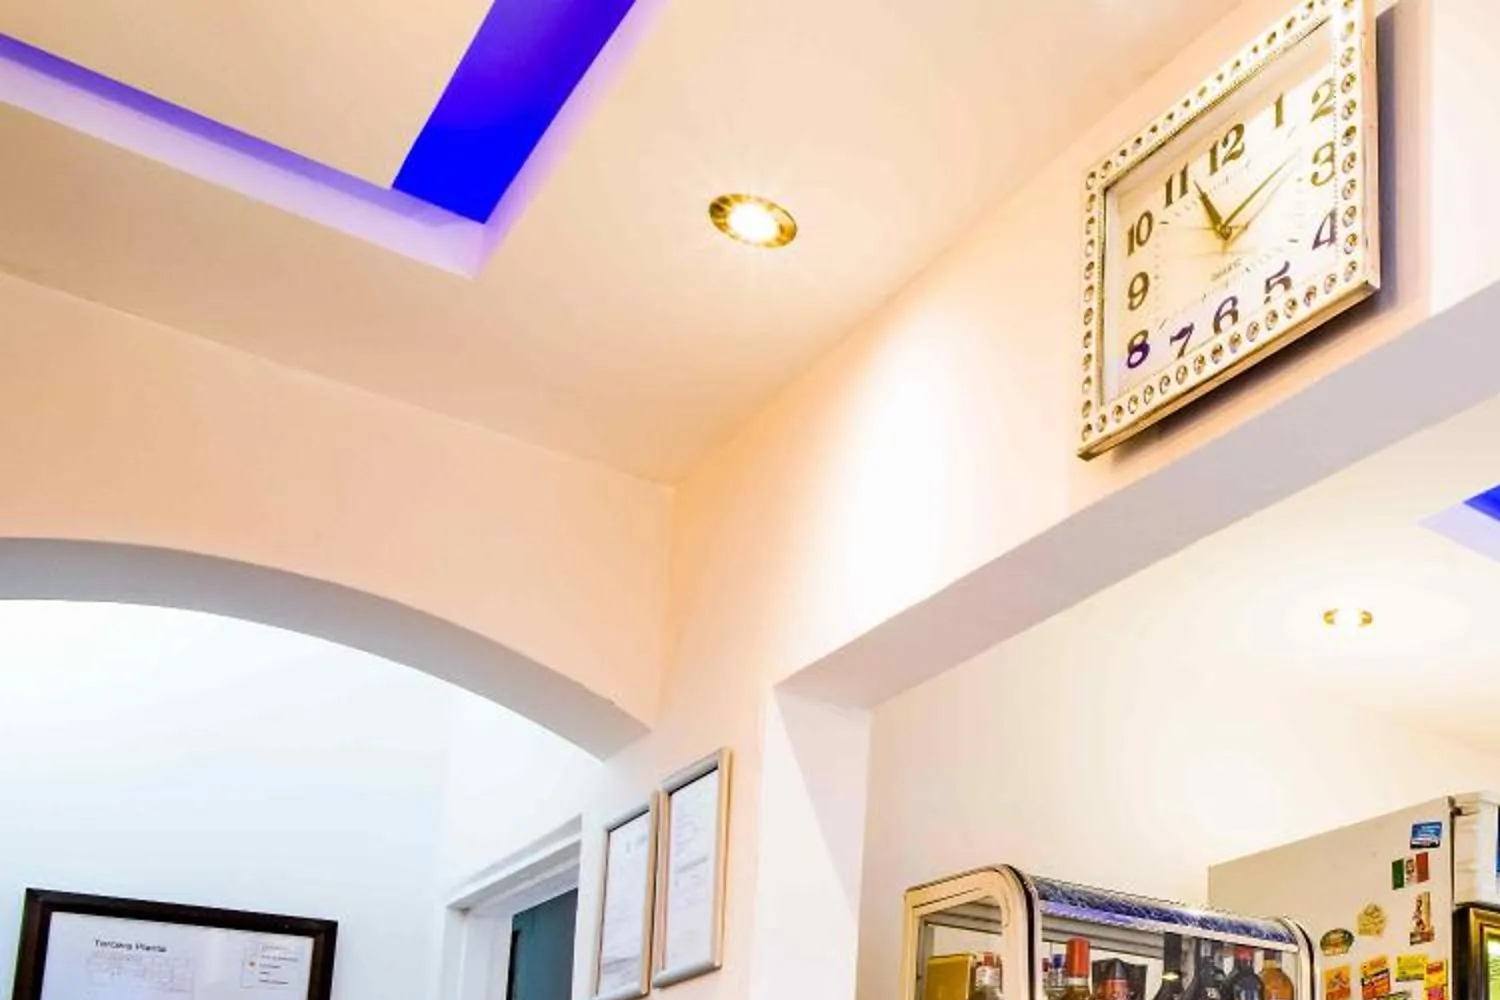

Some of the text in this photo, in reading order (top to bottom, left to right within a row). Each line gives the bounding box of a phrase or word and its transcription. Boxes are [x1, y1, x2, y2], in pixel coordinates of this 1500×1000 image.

[1270, 92, 1285, 129] 1
[1310, 77, 1337, 122] 2
[1207, 122, 1246, 176] 12
[1311, 140, 1337, 187] 3
[1162, 162, 1190, 209] 11
[1126, 210, 1154, 257] 10
[1311, 209, 1339, 250] 4
[1127, 271, 1150, 311] 9
[1263, 261, 1292, 304] 5
[1212, 295, 1240, 334] 6
[1125, 329, 1151, 369] 8
[1168, 322, 1195, 359] 7
